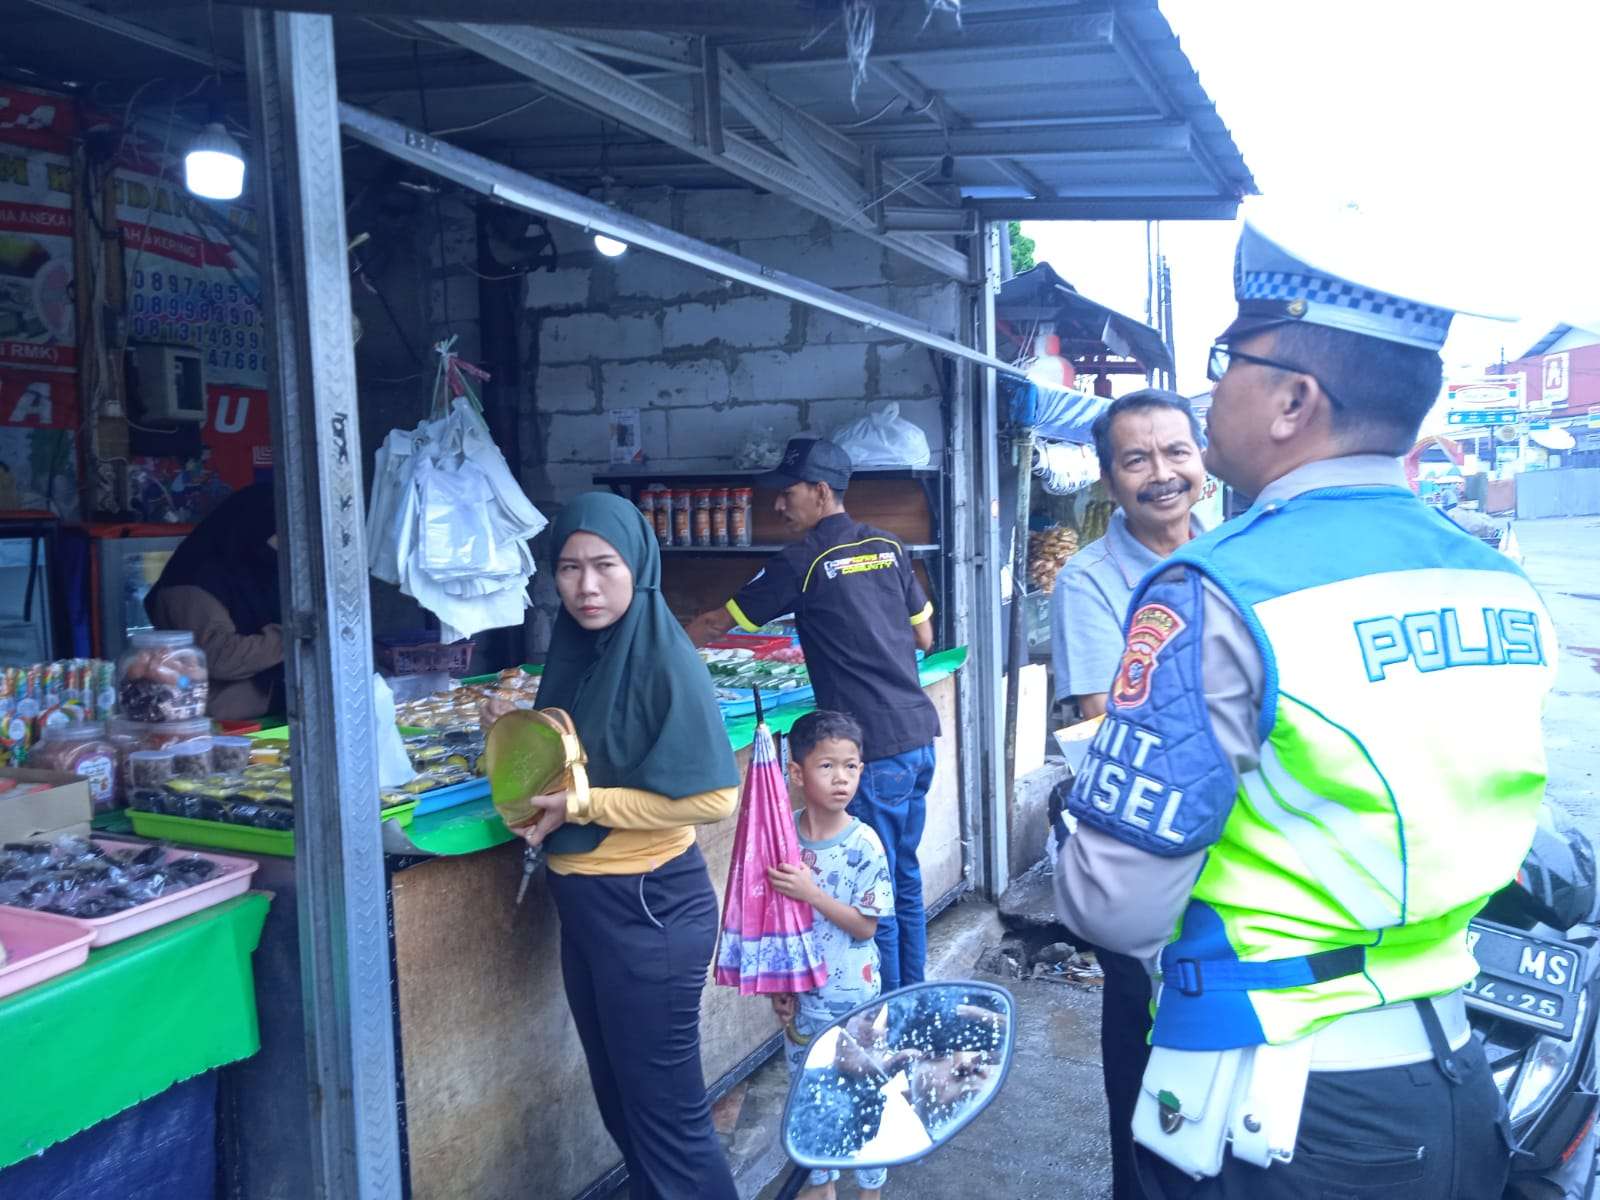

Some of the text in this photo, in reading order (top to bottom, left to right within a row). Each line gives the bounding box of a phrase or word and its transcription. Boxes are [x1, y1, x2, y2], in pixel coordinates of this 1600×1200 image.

[1354, 608, 1542, 682] POLIS
[1093, 717, 1163, 768] NIT
[1071, 754, 1185, 844] MSEL
[1519, 946, 1569, 985] MS
